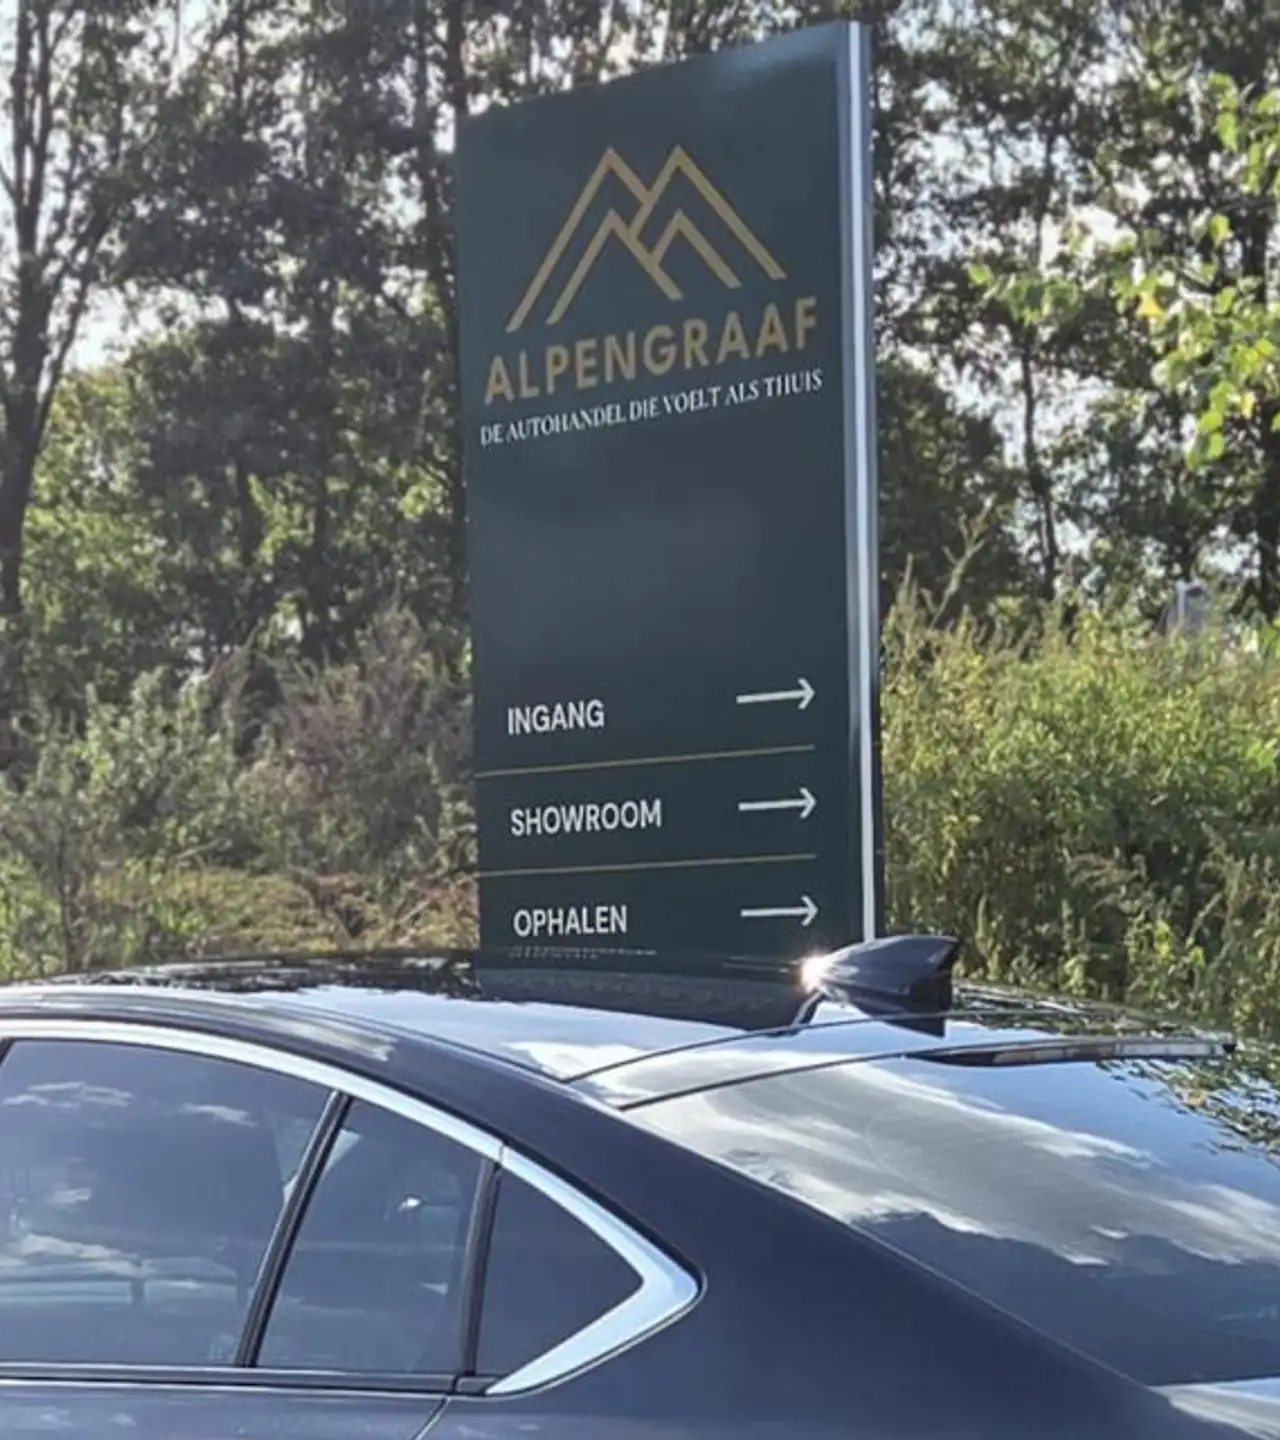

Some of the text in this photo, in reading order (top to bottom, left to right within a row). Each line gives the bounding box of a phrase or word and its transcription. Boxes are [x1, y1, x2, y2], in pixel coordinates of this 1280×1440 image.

[484, 297, 817, 404] ALPENGRAAF
[480, 368, 823, 446] DE AUTOHANDEL DIE VOELT ALS THUIS
[508, 700, 605, 735] INGANG
[511, 799, 662, 836] SHOWROOM
[514, 905, 627, 937] OPHALEN
